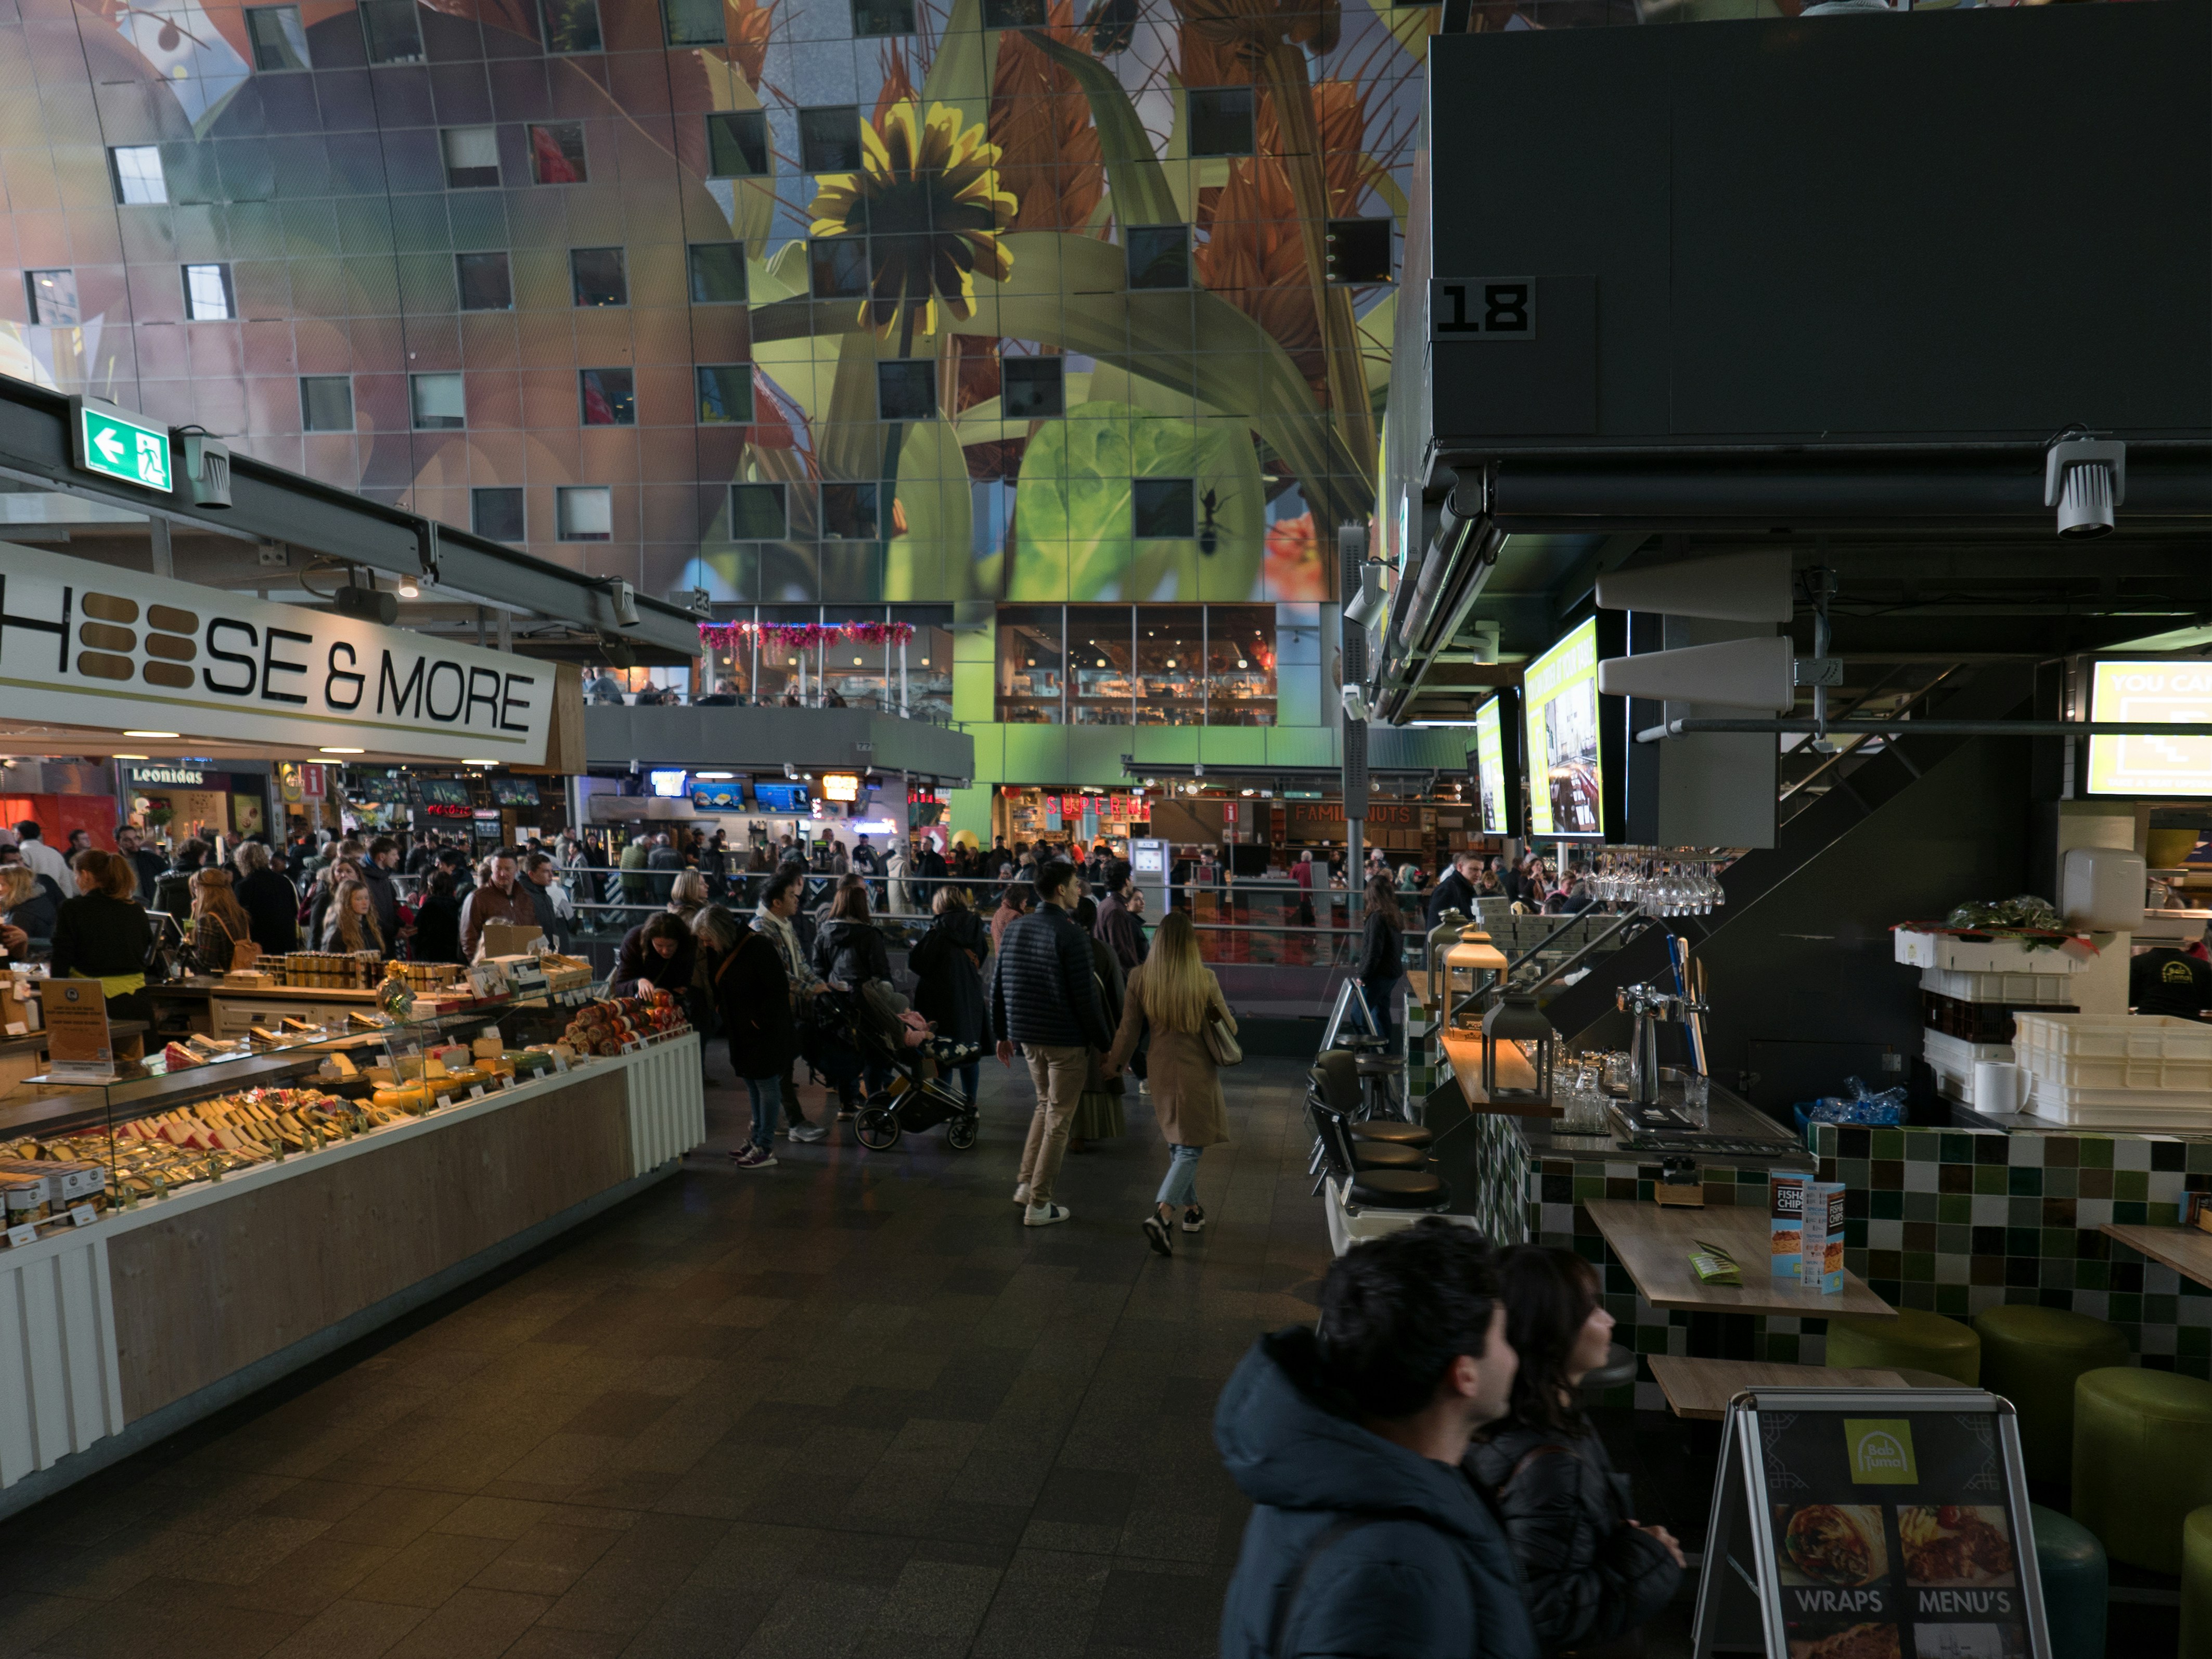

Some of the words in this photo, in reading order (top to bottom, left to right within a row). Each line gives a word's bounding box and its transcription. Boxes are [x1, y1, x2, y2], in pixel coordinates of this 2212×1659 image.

[1437, 284, 1528, 332] 18
[325, 641, 366, 711] &
[377, 649, 535, 732] MORE
[2111, 674, 2164, 692] YOU
[133, 767, 203, 785] Leonidas
[1295, 805, 1349, 822] FAMIL
[1365, 806, 1410, 823] NUTS
[1829, 1211, 1844, 1224] CHIPS
[1830, 1202, 1844, 1215] FISH&
[1868, 1440, 1895, 1456] Bab
[1864, 1455, 1901, 1471] Tuma
[1795, 1590, 1883, 1613] WRAPS
[1919, 1590, 2012, 1613] MENU'S
